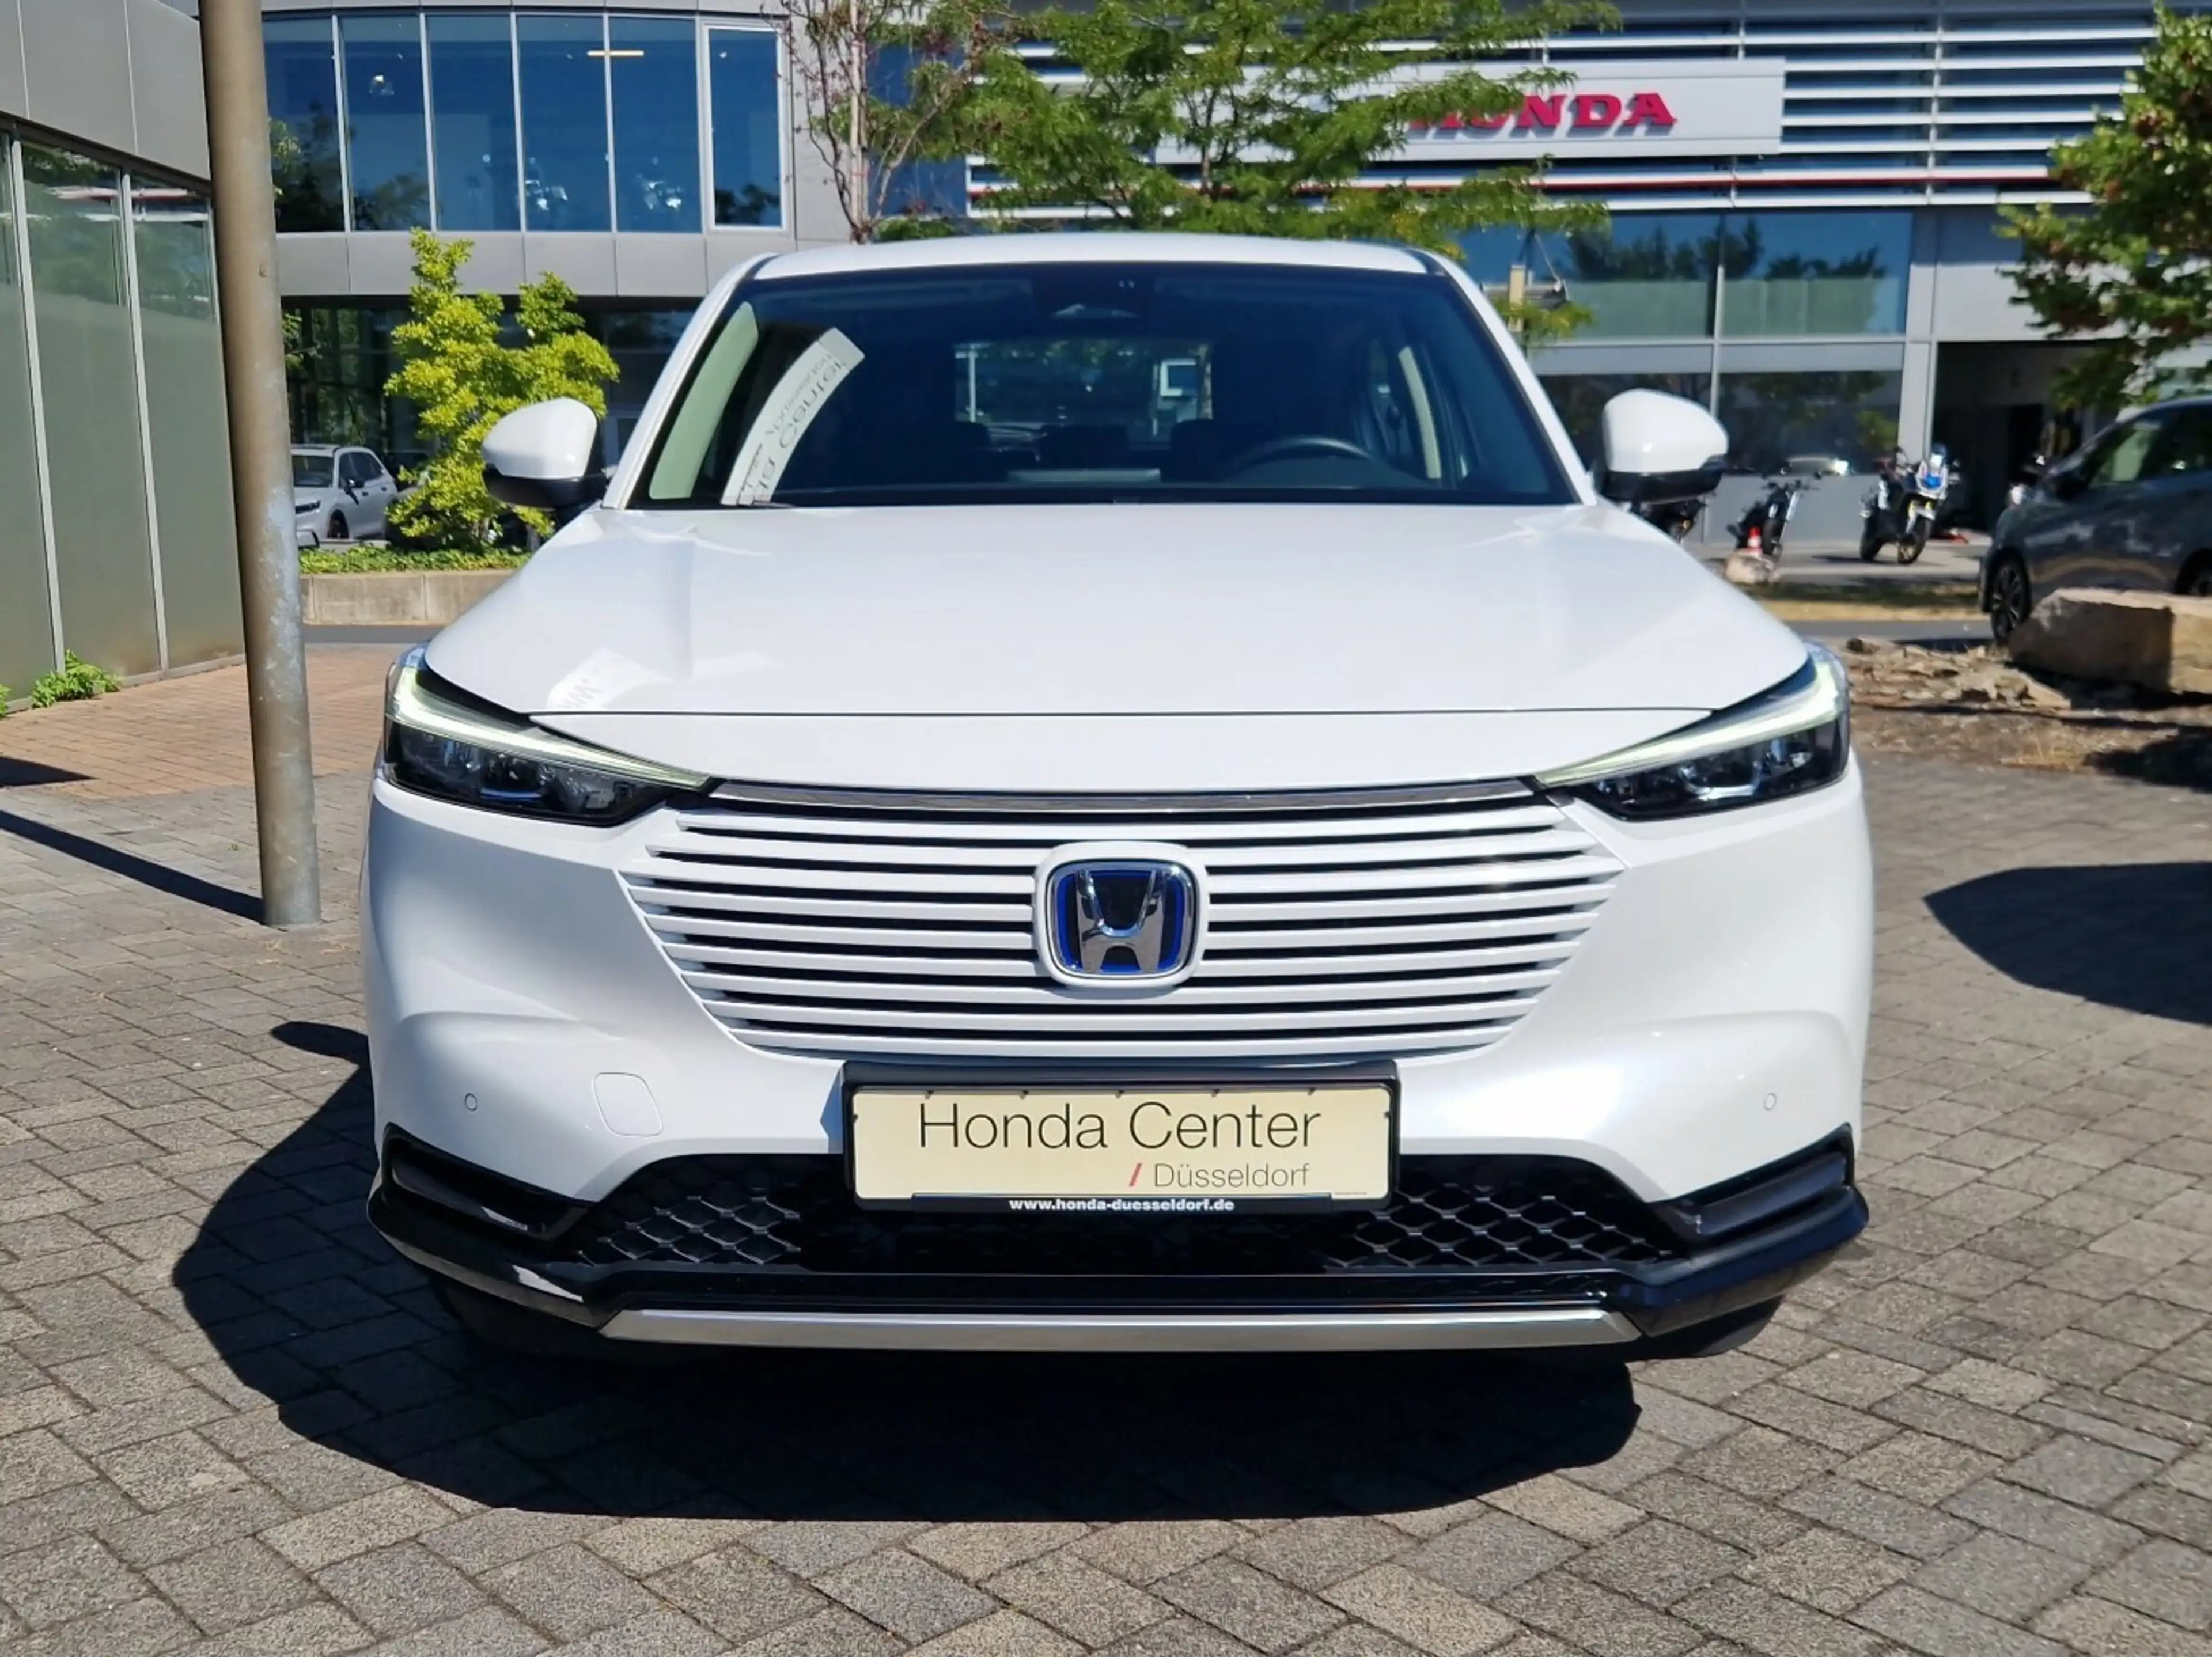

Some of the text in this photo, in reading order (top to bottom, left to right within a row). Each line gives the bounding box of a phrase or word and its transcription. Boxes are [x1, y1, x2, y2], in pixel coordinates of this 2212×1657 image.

[920, 1101, 1321, 1150] Honda Center
[1154, 1162, 1310, 1188] Düsseldorf
[1009, 1198, 1235, 1211] www.honda-duesseldorf.de
